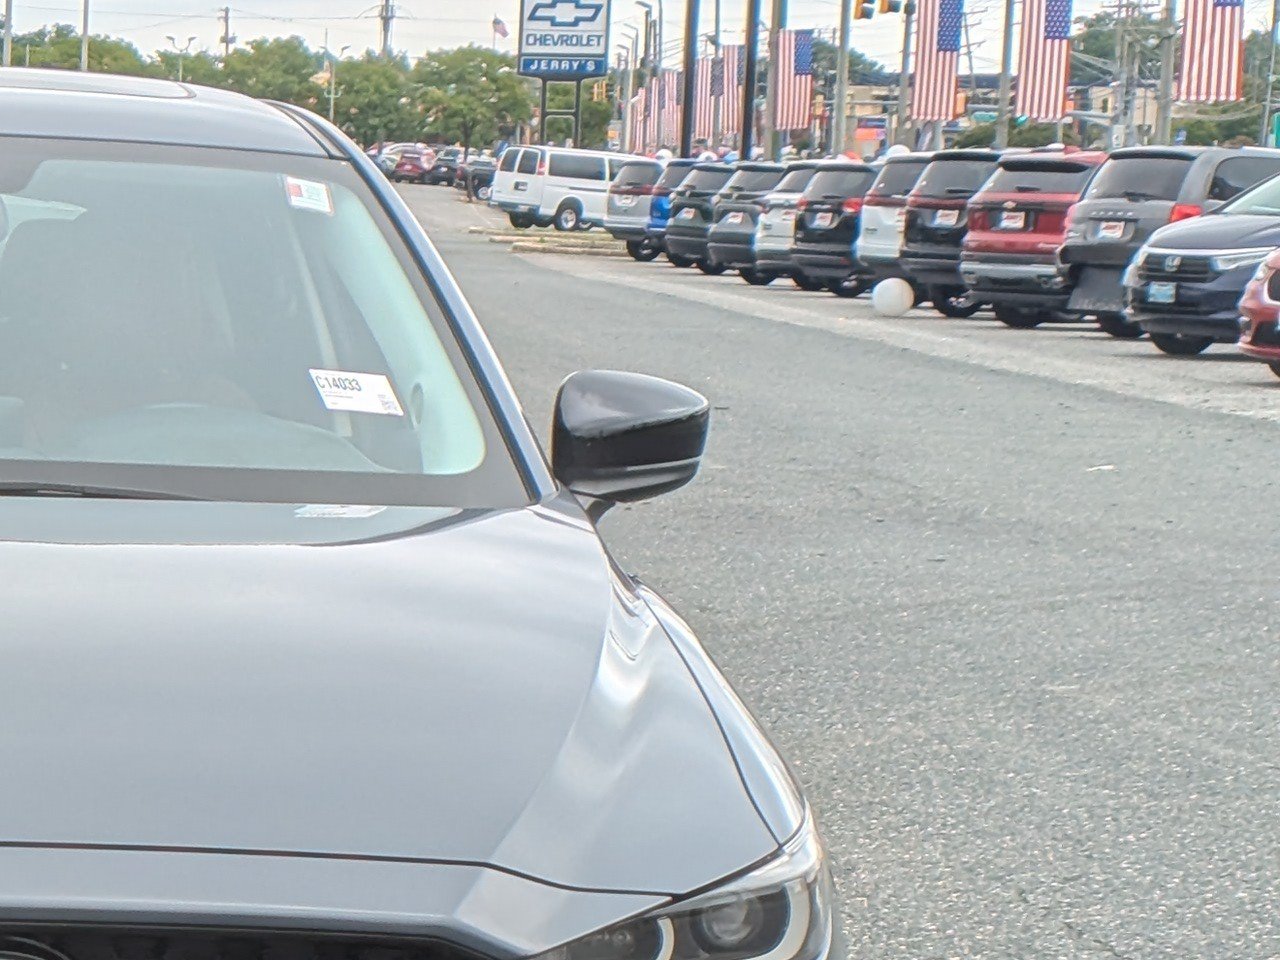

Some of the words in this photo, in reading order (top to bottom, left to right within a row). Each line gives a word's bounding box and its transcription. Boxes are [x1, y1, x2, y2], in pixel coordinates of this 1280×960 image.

[526, 33, 604, 46] CHEVROLET
[529, 59, 596, 71] JERRY'S
[315, 375, 362, 392] C14033
